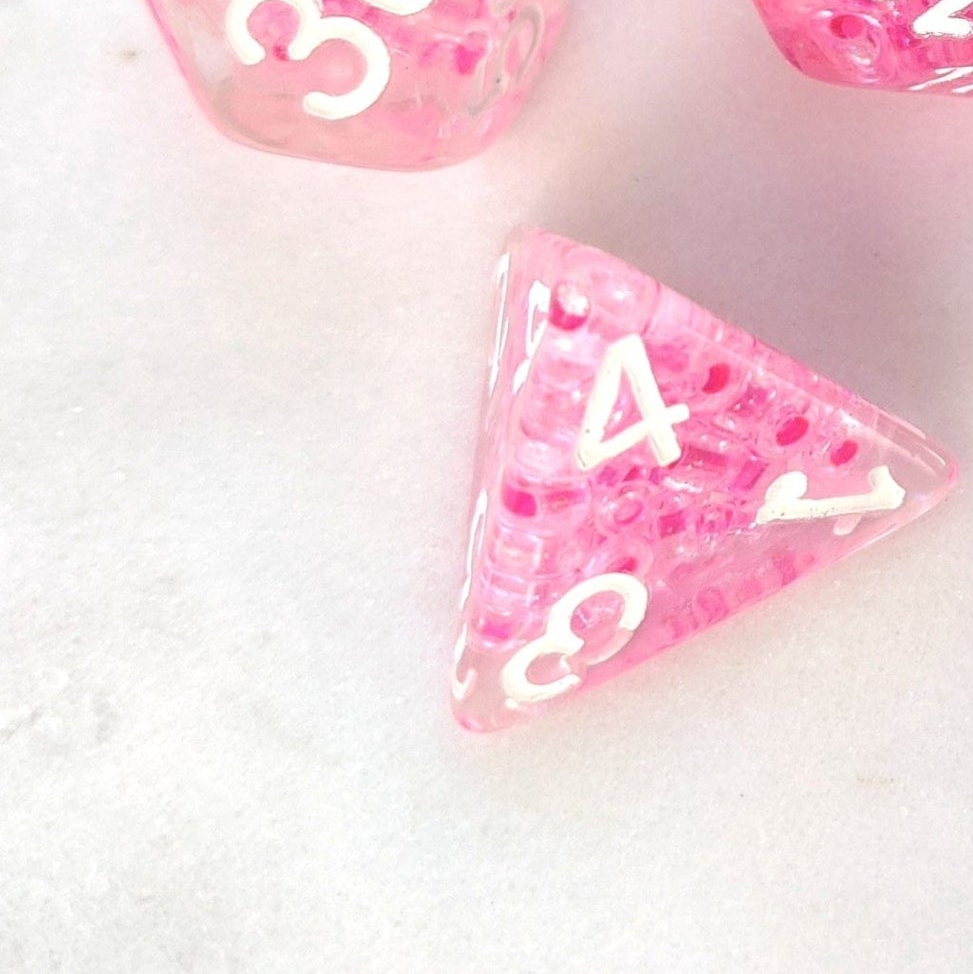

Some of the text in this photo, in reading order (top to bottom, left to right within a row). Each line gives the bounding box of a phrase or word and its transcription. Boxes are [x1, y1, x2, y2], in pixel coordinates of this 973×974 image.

[575, 332, 691, 473] 4
[754, 464, 908, 528] 1
[502, 571, 650, 710] 3
